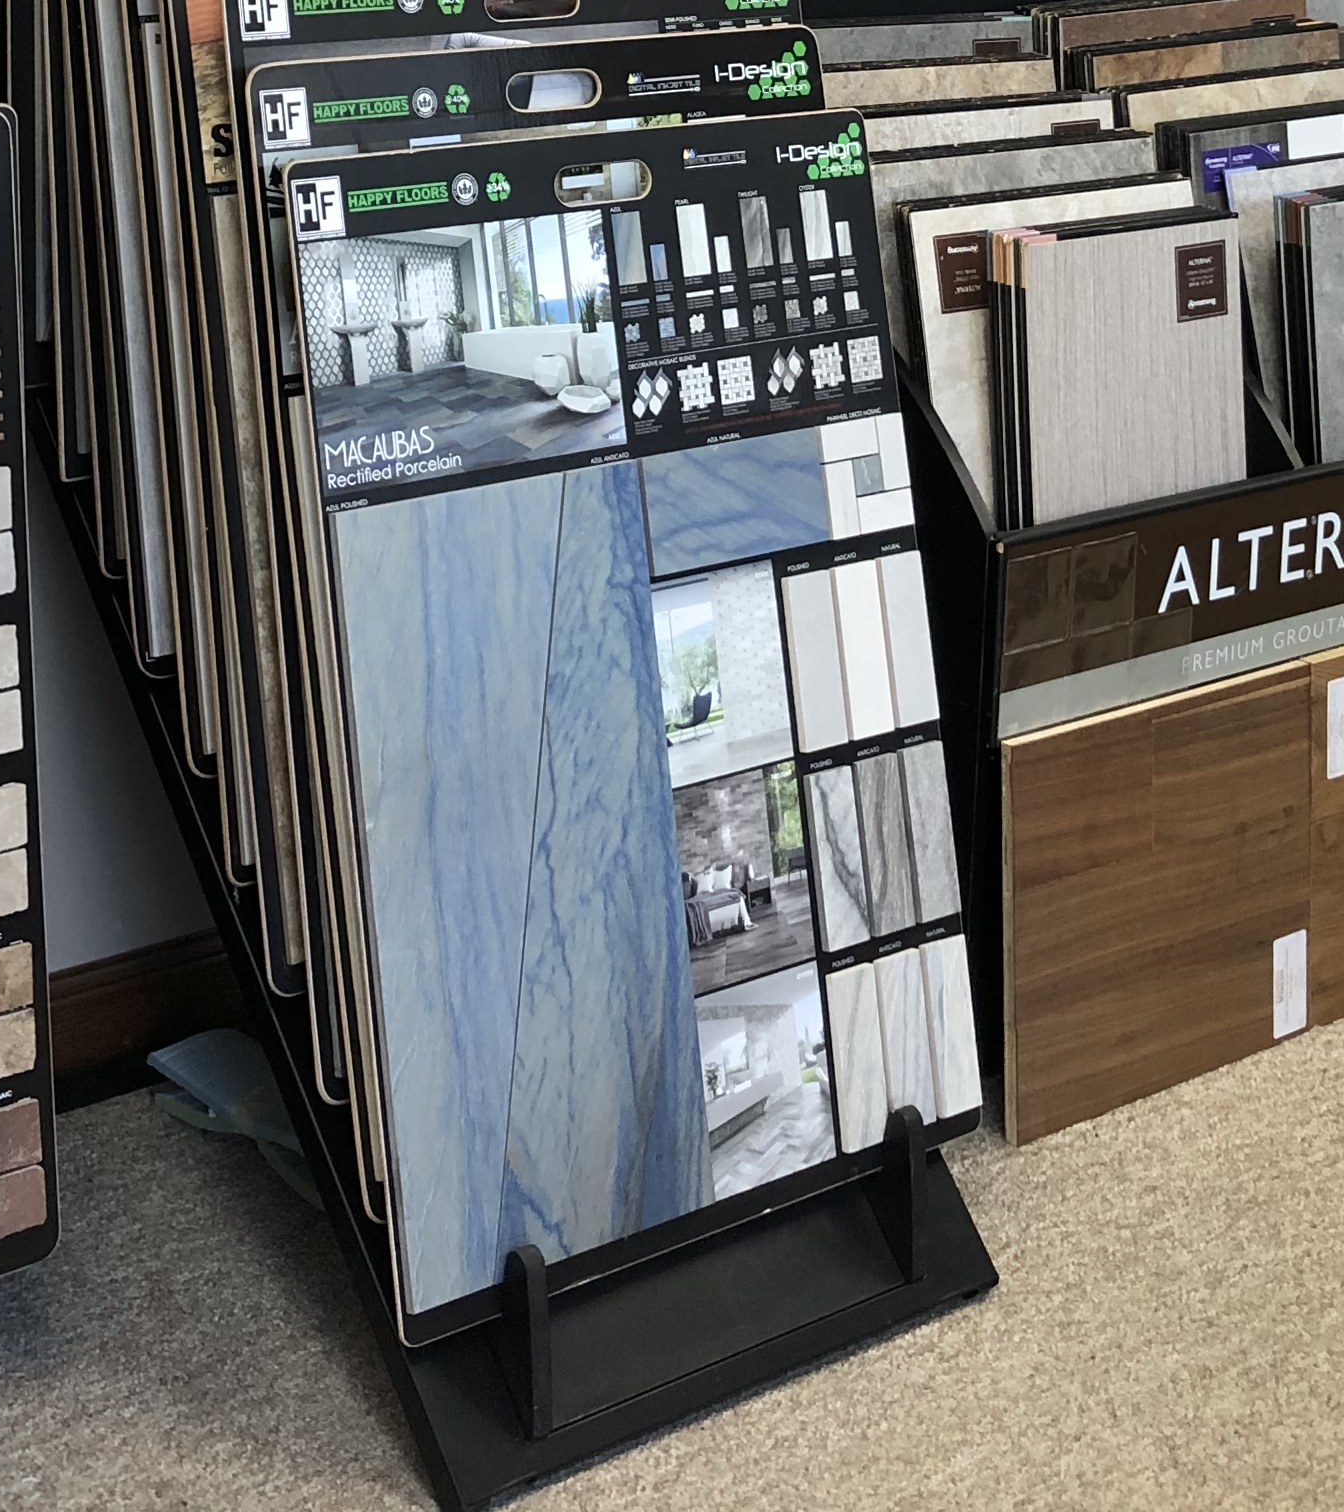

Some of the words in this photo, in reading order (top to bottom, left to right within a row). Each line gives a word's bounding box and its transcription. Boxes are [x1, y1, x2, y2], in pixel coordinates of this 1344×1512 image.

[714, 59, 807, 83] I-Design
[761, 82, 808, 94] Collection
[313, 102, 356, 120] HAPPY
[359, 99, 410, 117] FLOORS
[776, 141, 860, 164] I-Design
[820, 161, 862, 175] Collection
[348, 191, 393, 210] HAPPY
[396, 185, 449, 203] FLOORS
[323, 425, 436, 471] MACAUBAS
[326, 463, 393, 489] Rectified
[395, 453, 463, 478] Porcelain
[340, 498, 369, 509] POLISHED
[1181, 636, 1265, 675] PREMIUM
